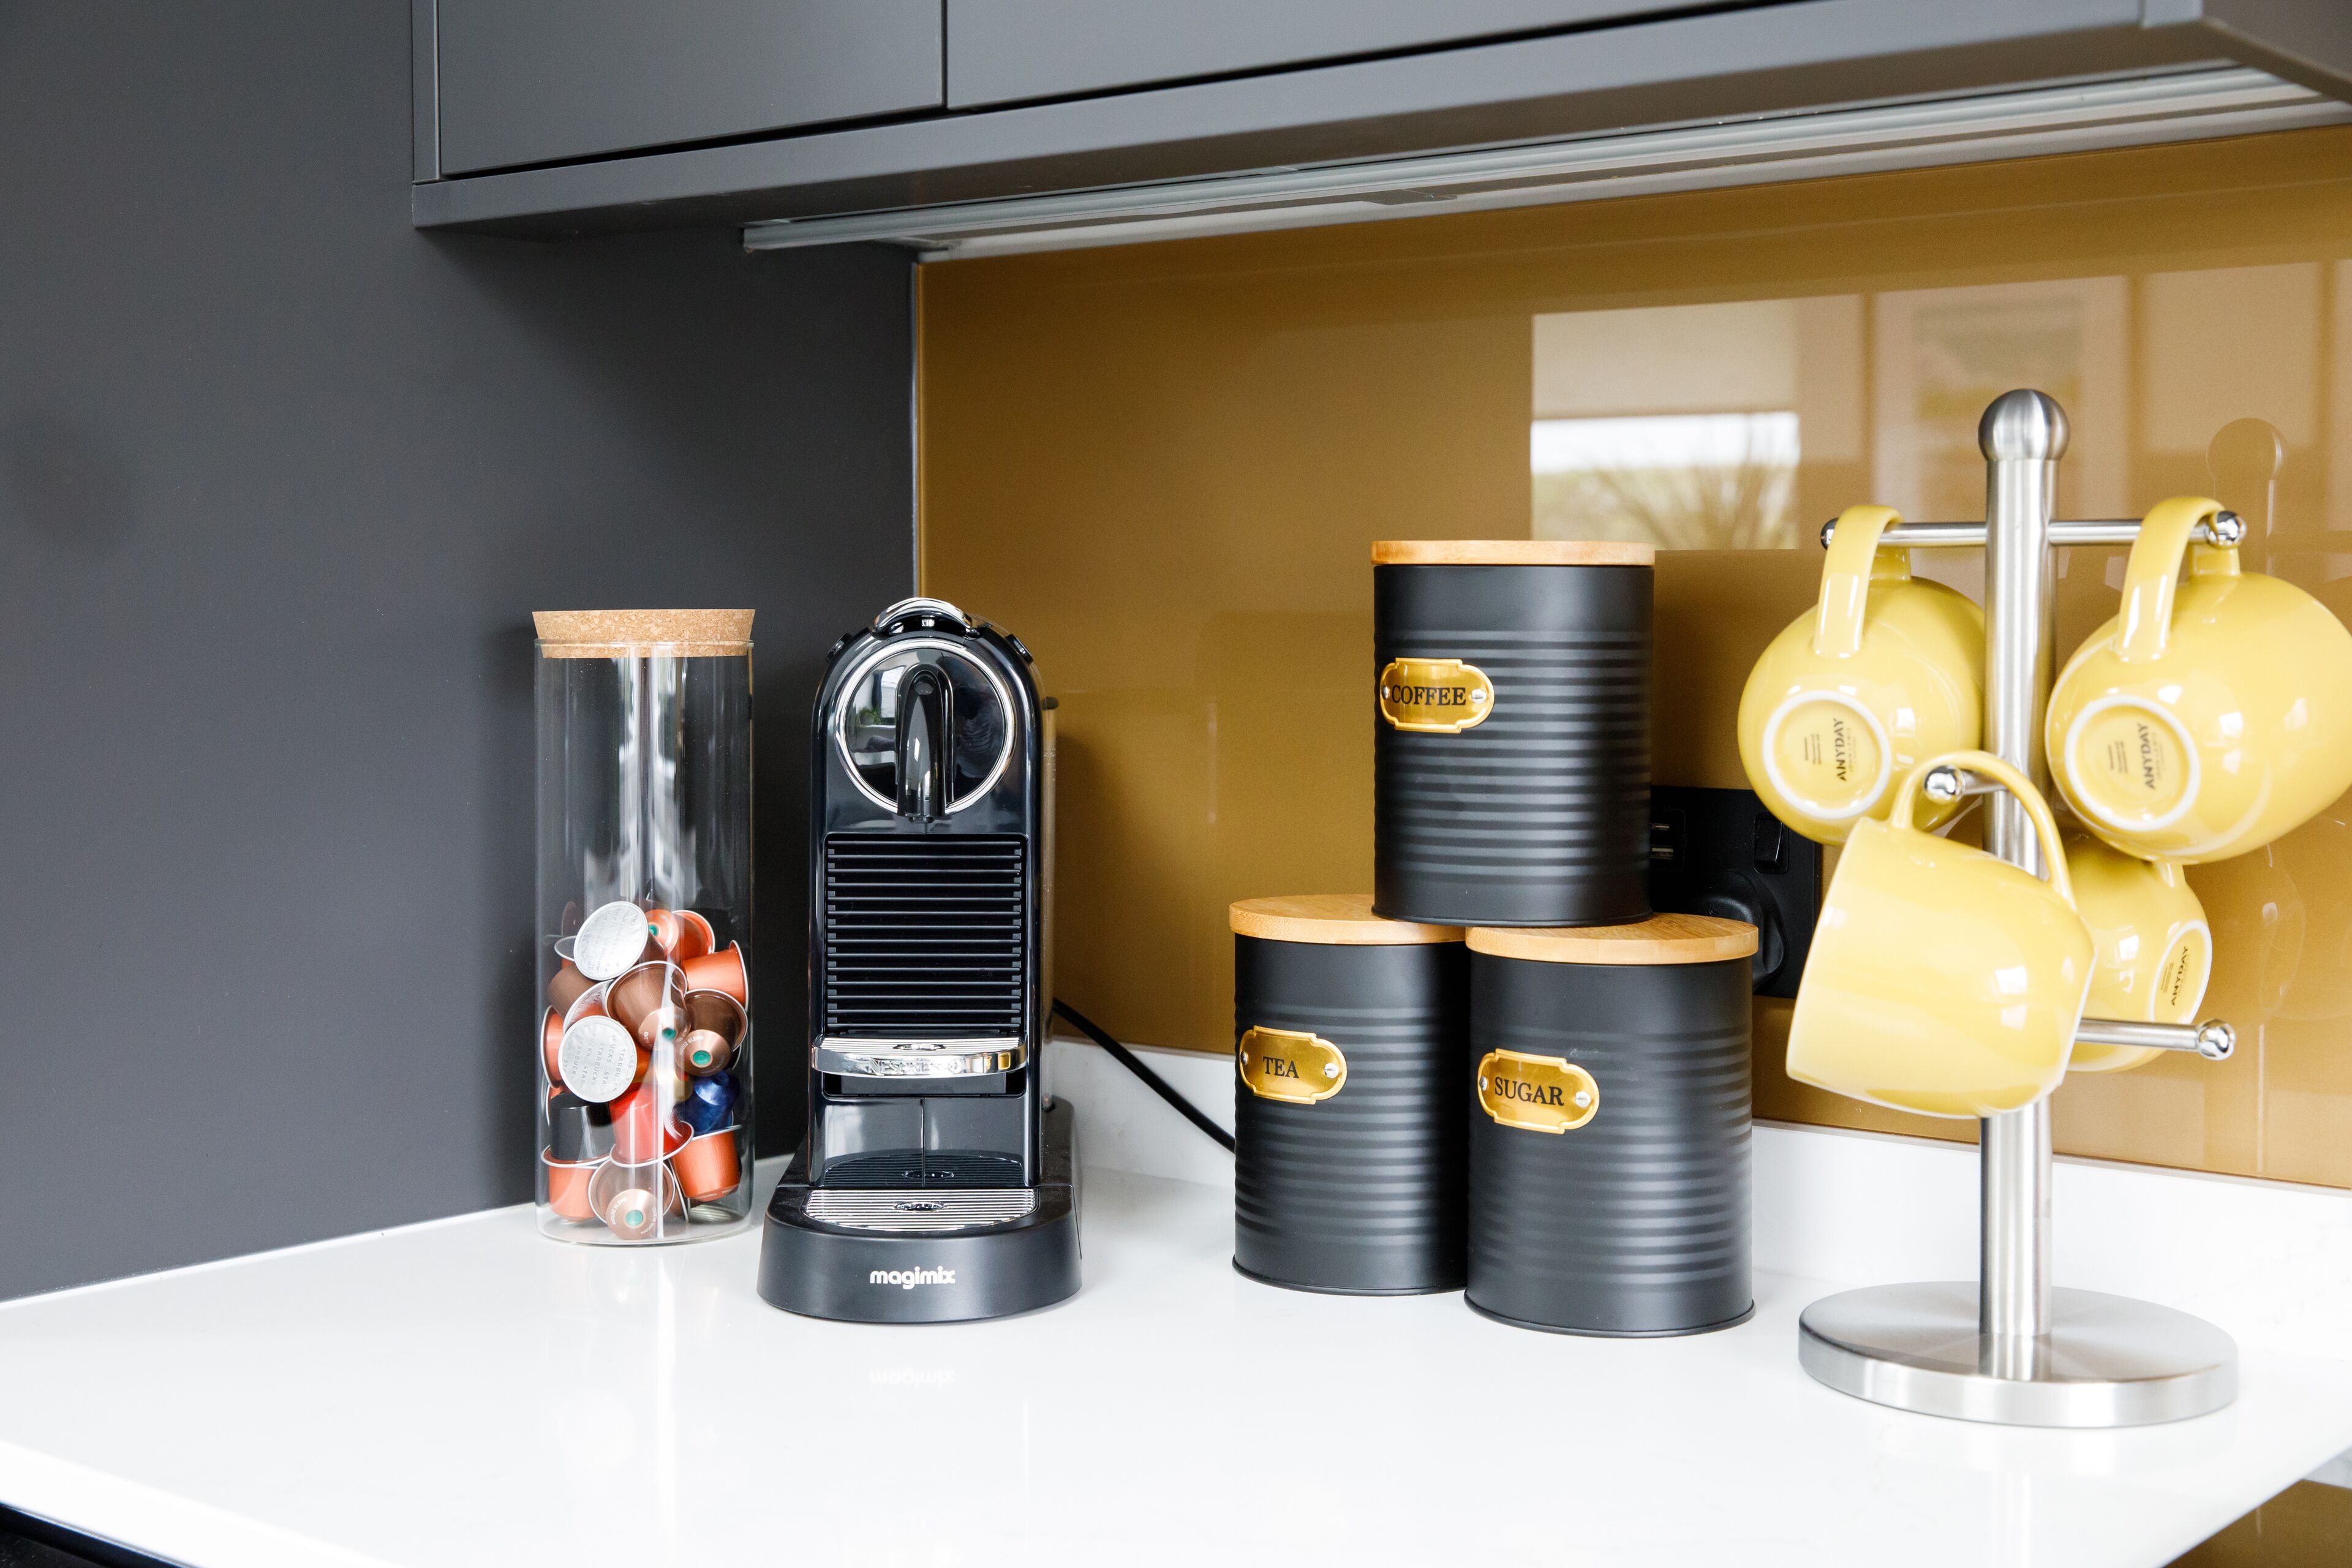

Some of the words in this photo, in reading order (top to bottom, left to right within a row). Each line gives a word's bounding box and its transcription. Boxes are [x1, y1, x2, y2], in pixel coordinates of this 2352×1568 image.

[1392, 685, 1466, 706] COFFEE
[1833, 718, 1847, 782] ANYDAY
[2137, 722, 2156, 790] ANYDAY
[2171, 946, 2188, 1006] ANYDAY
[688, 1035, 704, 1043] BLEND
[868, 1057, 962, 1076] NESPRESO
[1262, 1055, 1300, 1079] TEA
[1494, 1076, 1565, 1106] SUGAR
[613, 1196, 628, 1210] BLEND
[870, 1265, 956, 1290] magimix
